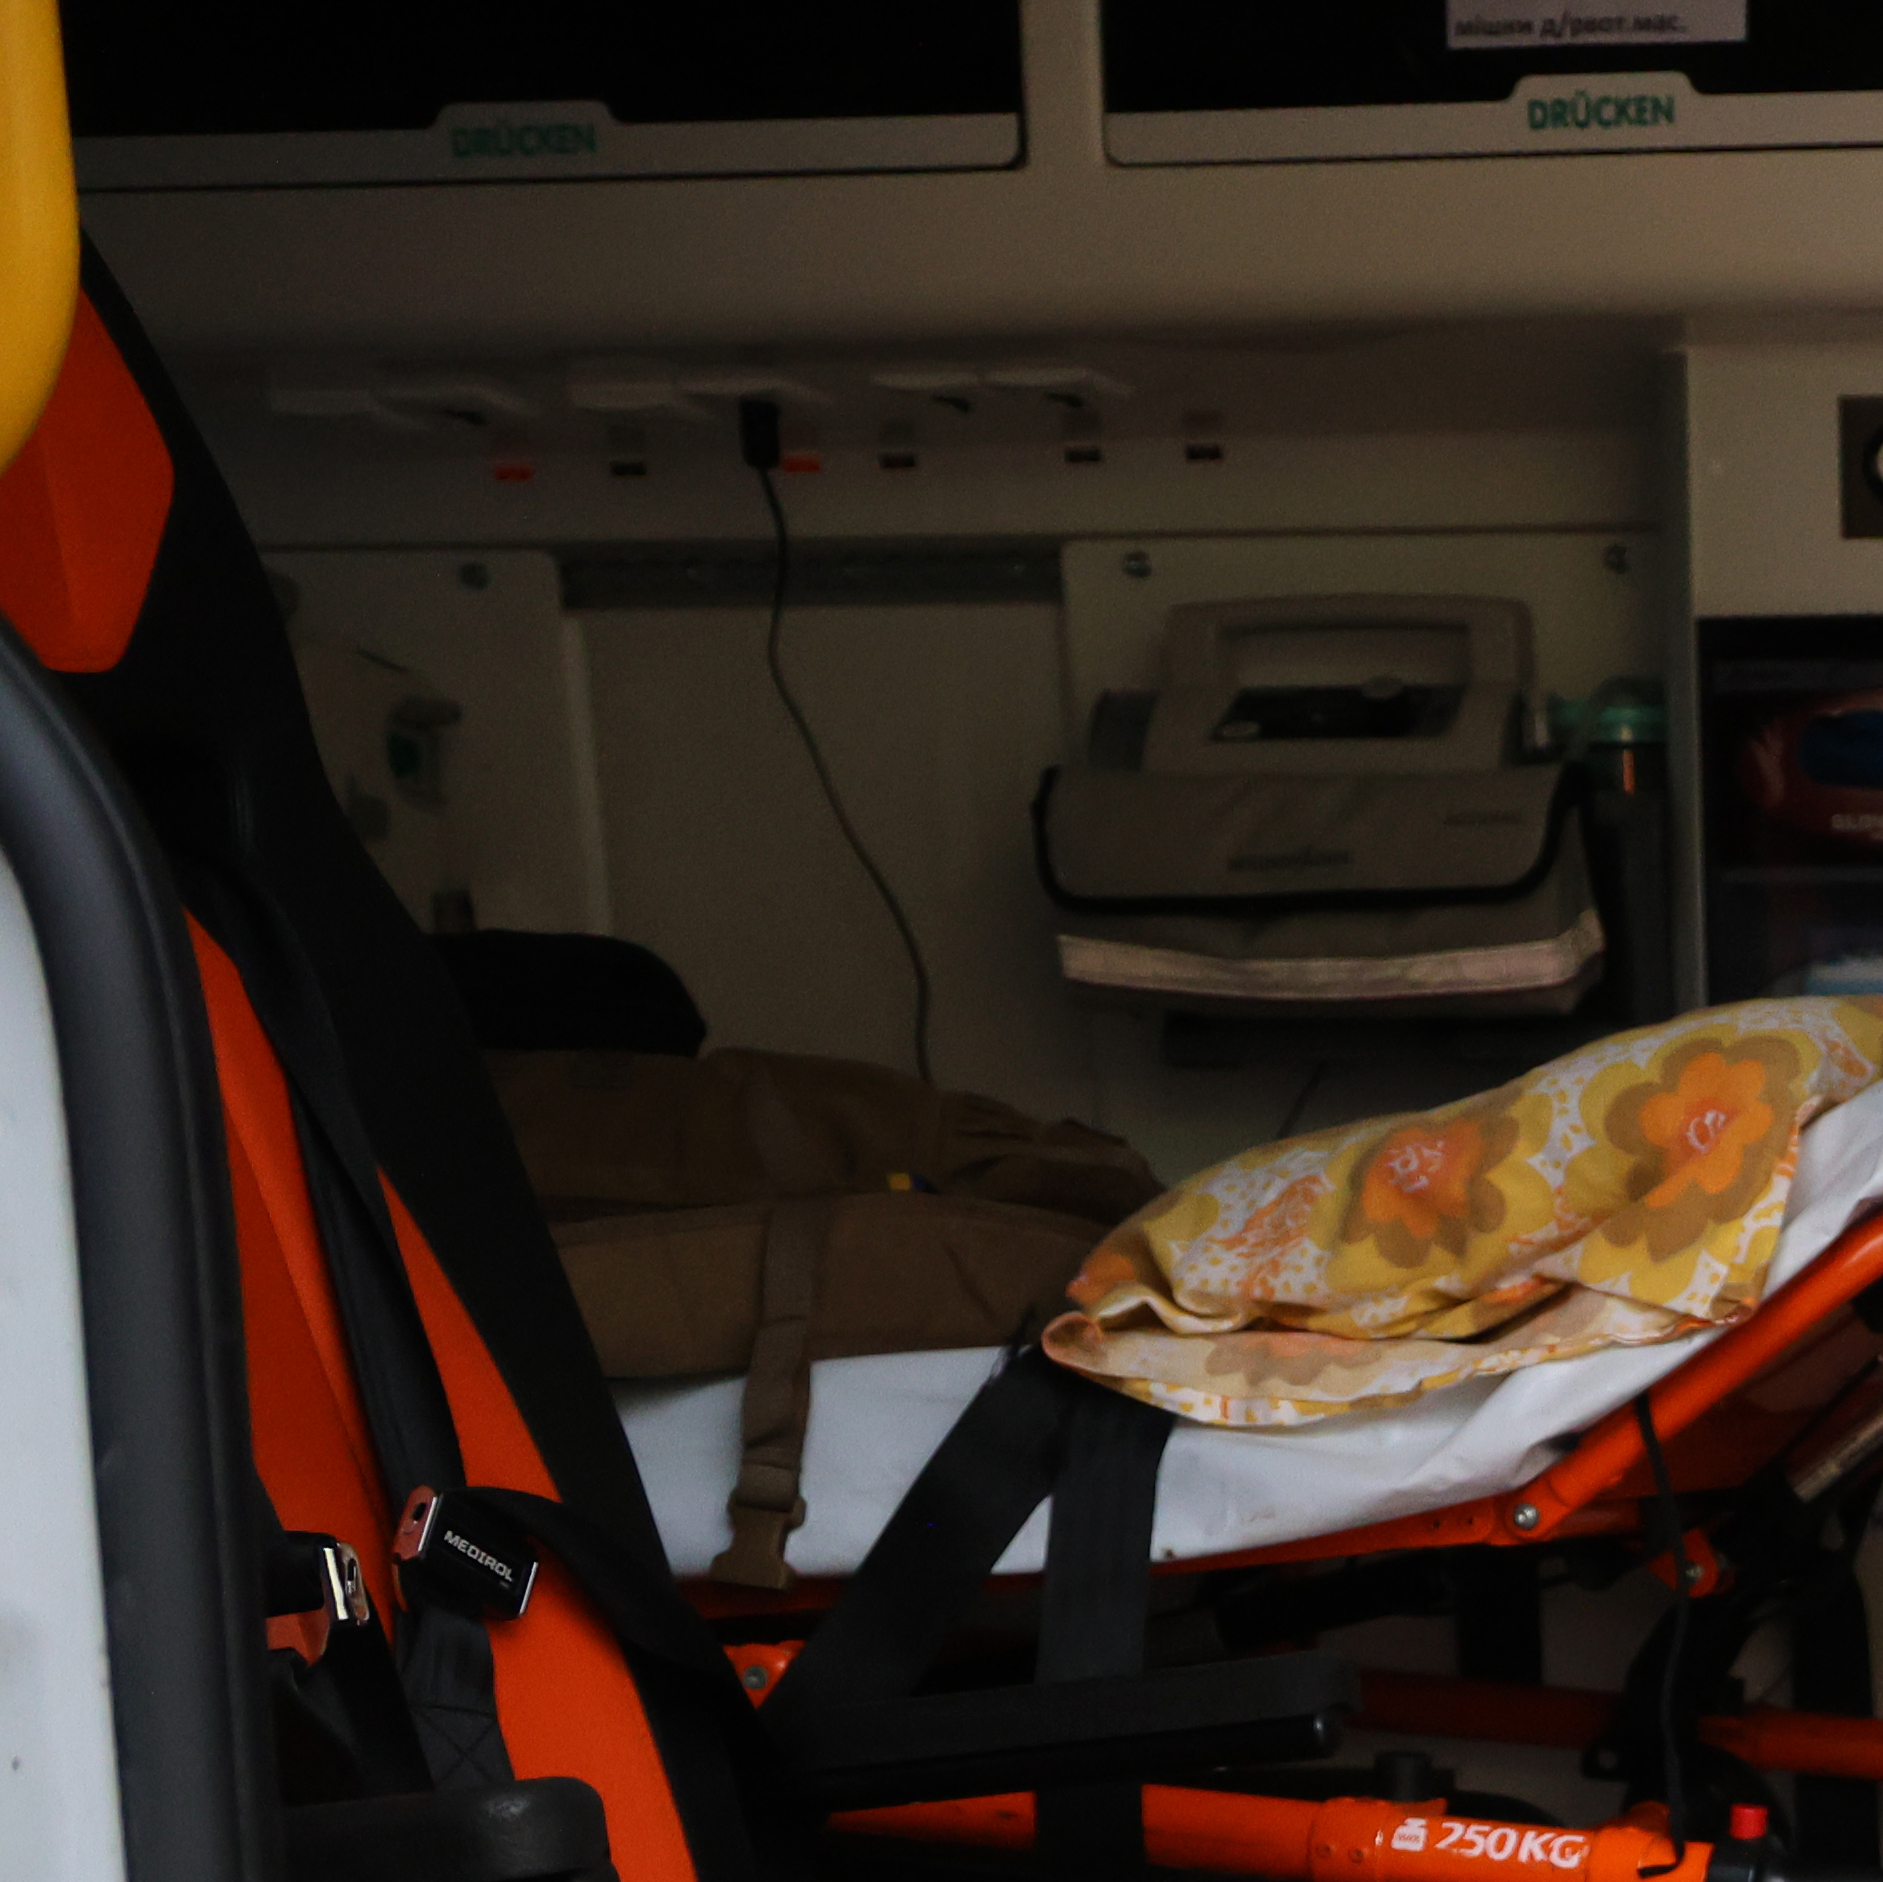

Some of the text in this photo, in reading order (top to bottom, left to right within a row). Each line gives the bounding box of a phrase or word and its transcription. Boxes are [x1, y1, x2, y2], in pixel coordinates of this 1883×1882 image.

[1526, 89, 1677, 130] DRÜCKEN
[443, 1529, 515, 1583] MEDIROL
[1434, 1821, 1587, 1869] 250KG
